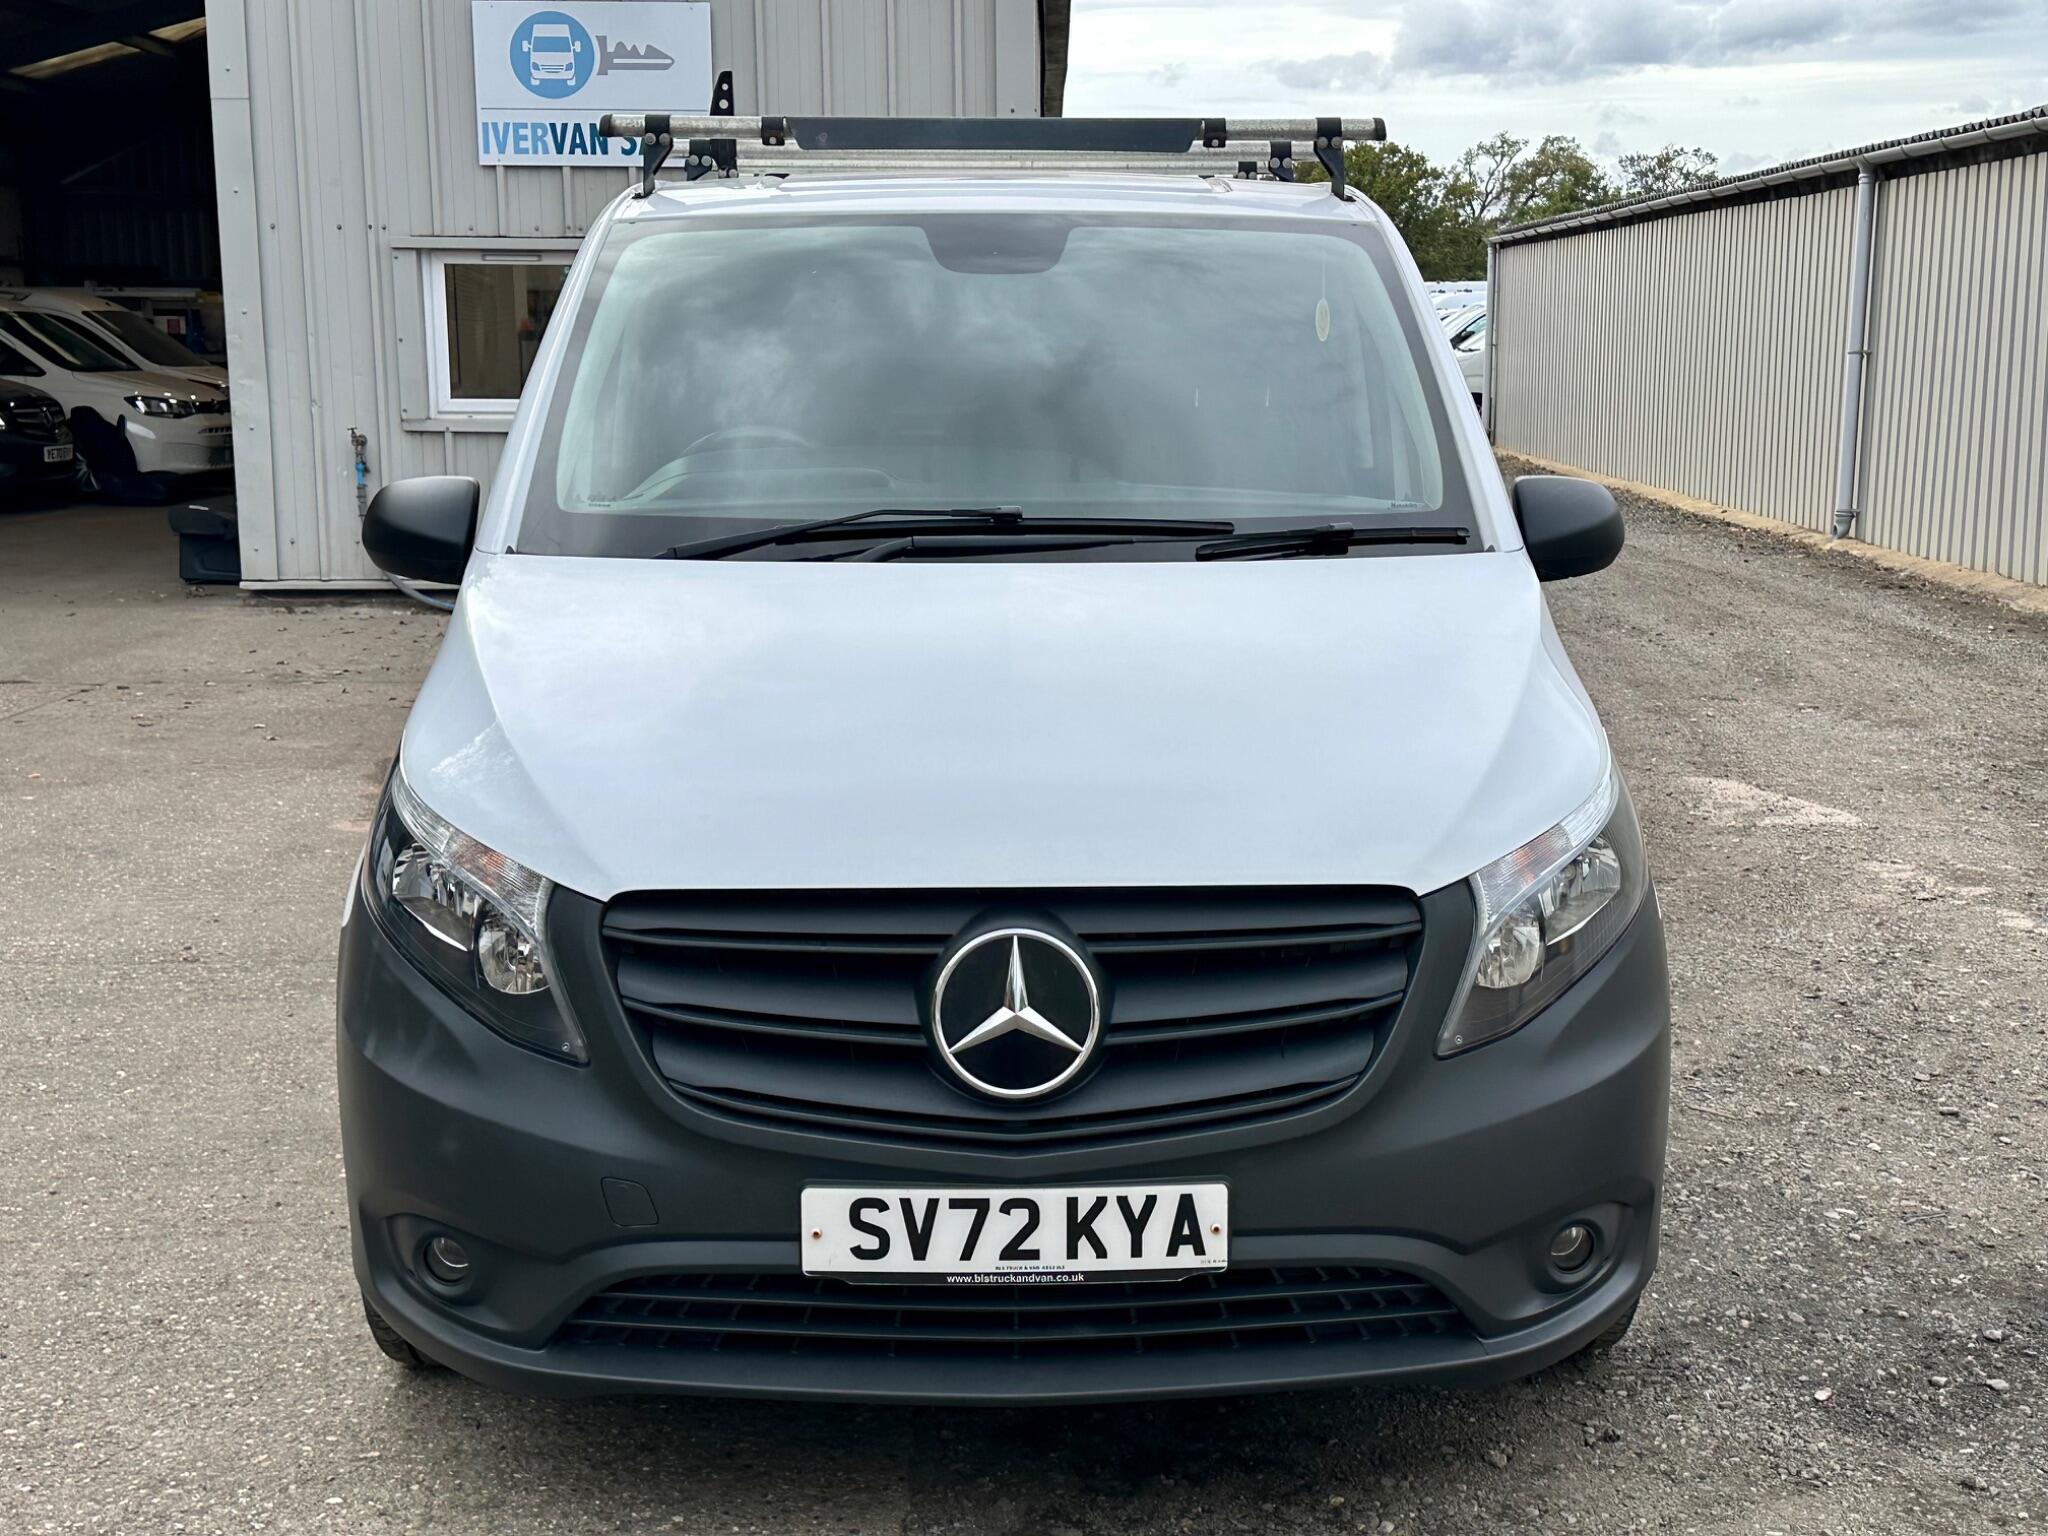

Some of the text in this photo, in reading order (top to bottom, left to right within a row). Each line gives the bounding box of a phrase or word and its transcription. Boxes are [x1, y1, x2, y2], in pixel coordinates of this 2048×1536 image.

[481, 121, 609, 156] IVERVAN
[848, 1193, 1207, 1262] SV72 KYA
[946, 1272, 1085, 1283] www.blstruckandvan.co.uk
